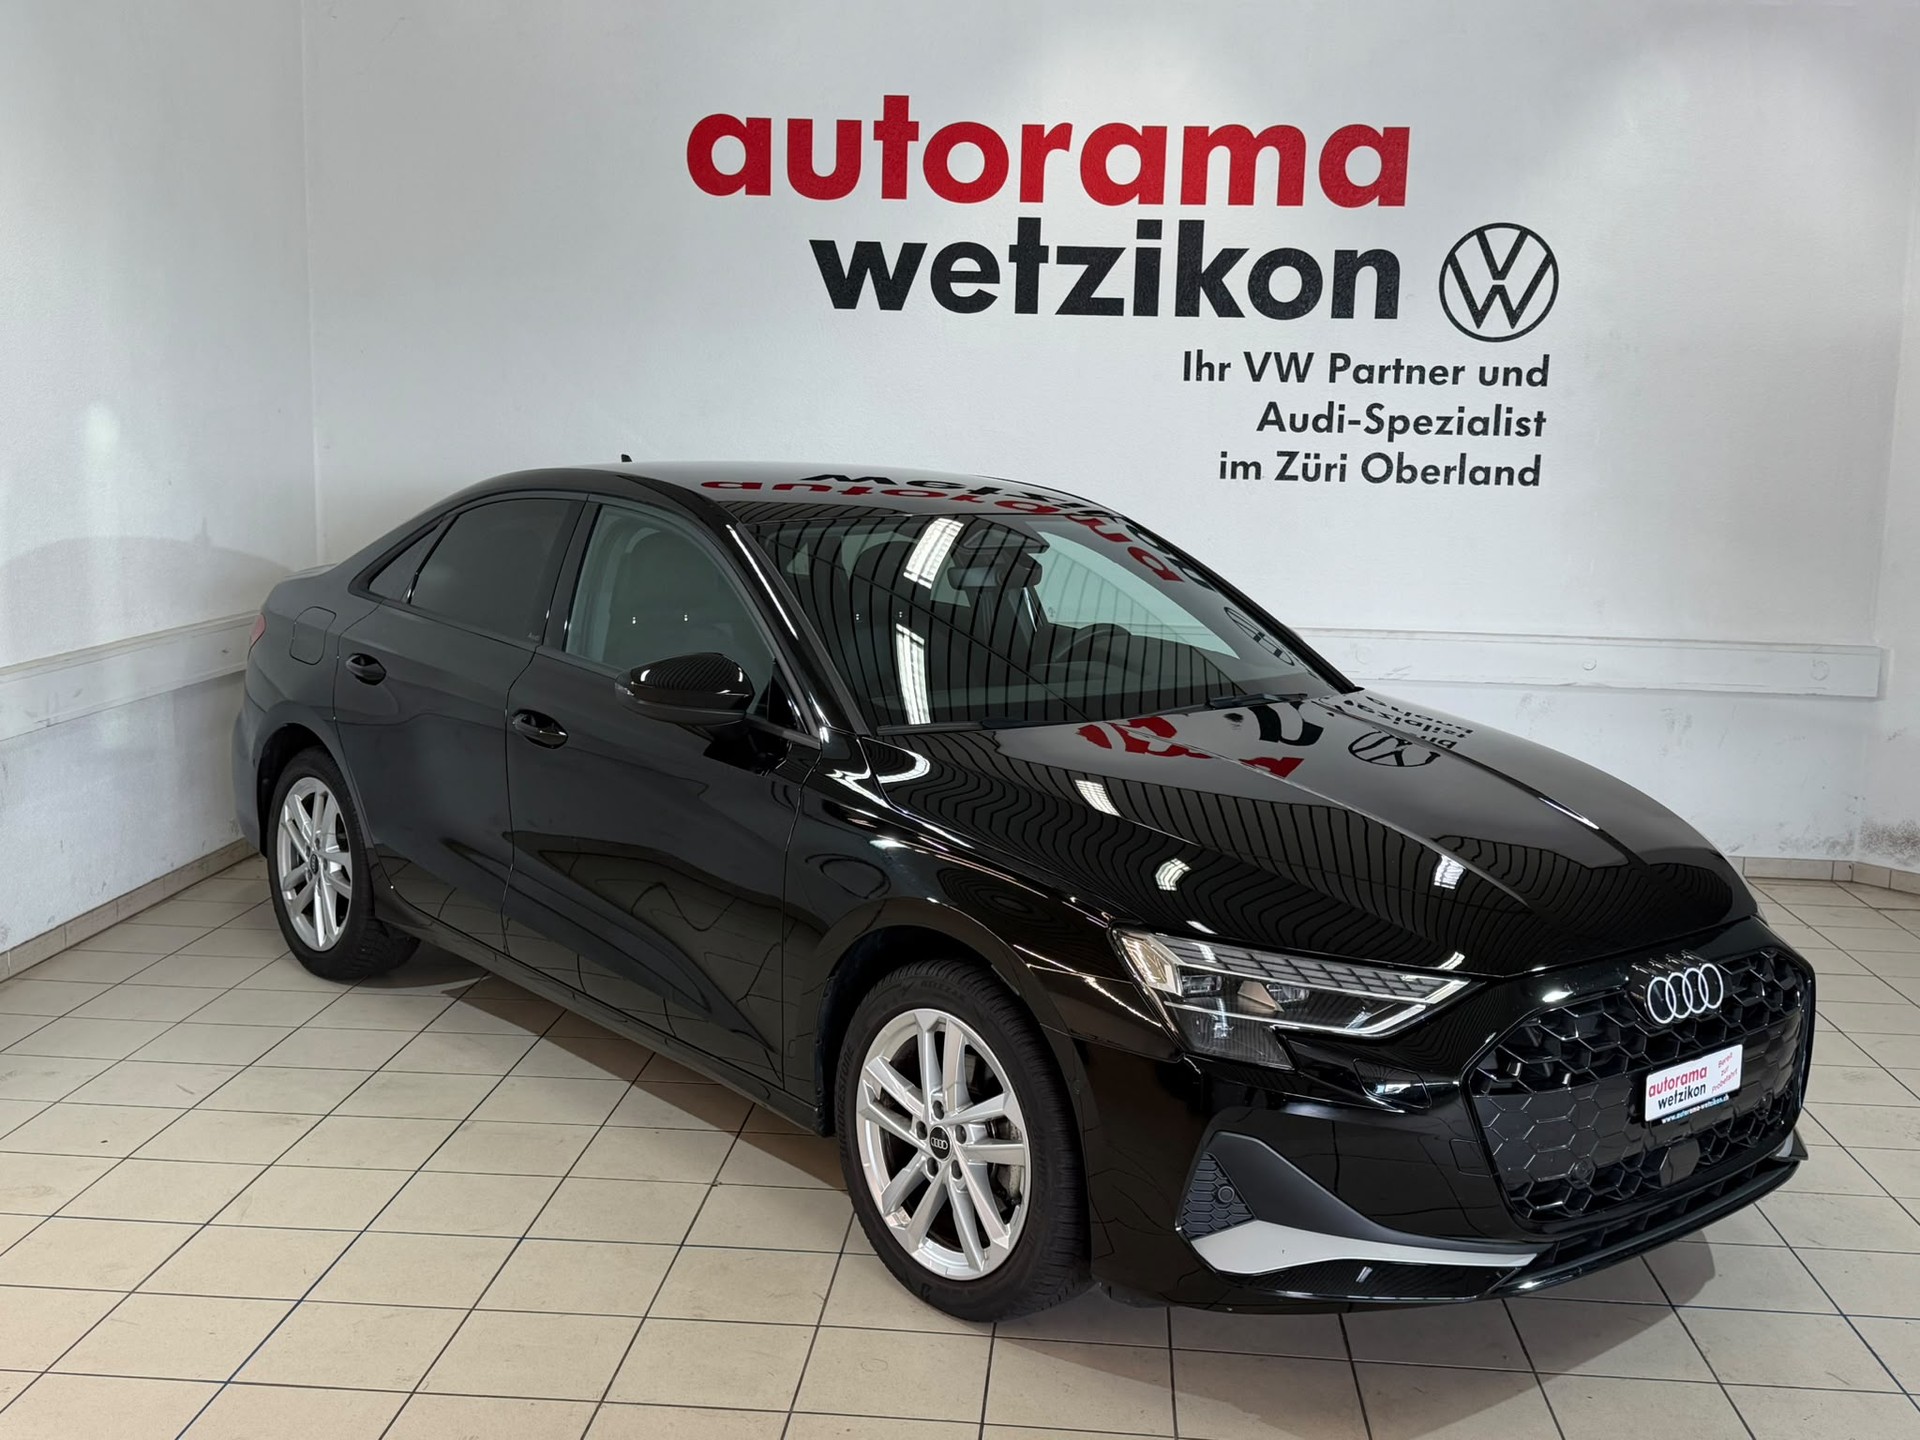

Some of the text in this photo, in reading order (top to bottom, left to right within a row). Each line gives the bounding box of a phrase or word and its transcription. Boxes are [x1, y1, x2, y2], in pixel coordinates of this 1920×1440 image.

[686, 95, 1410, 208] autorama
[809, 217, 1400, 320] wetzikon
[1183, 349, 1550, 387] Ihr VW Partner und
[1256, 401, 1547, 443] Audi-Spezialist
[1219, 451, 1542, 487] im Züri Oberland
[1648, 1066, 1708, 1098] autorama
[1658, 1084, 1706, 1110] wetzikon
